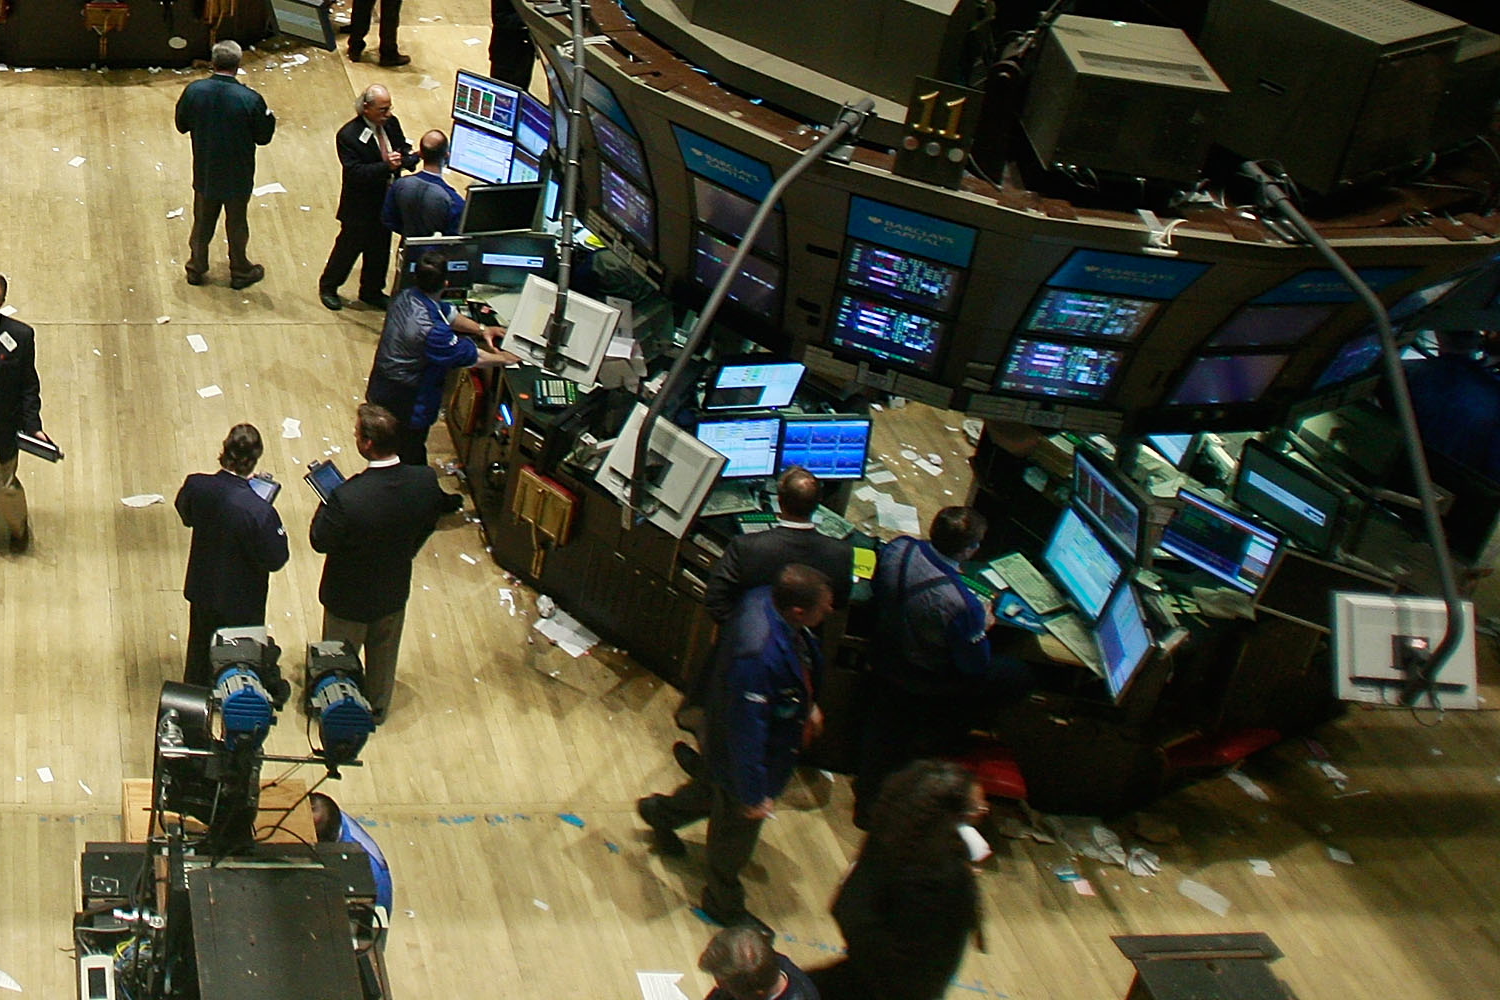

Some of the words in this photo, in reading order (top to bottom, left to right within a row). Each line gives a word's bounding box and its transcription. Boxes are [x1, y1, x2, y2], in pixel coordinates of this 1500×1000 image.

[912, 91, 968, 140] 11
[703, 153, 761, 183] BARCLAYS
[883, 220, 955, 244] BARCLAYS
[883, 227, 941, 247] CAPITAL
